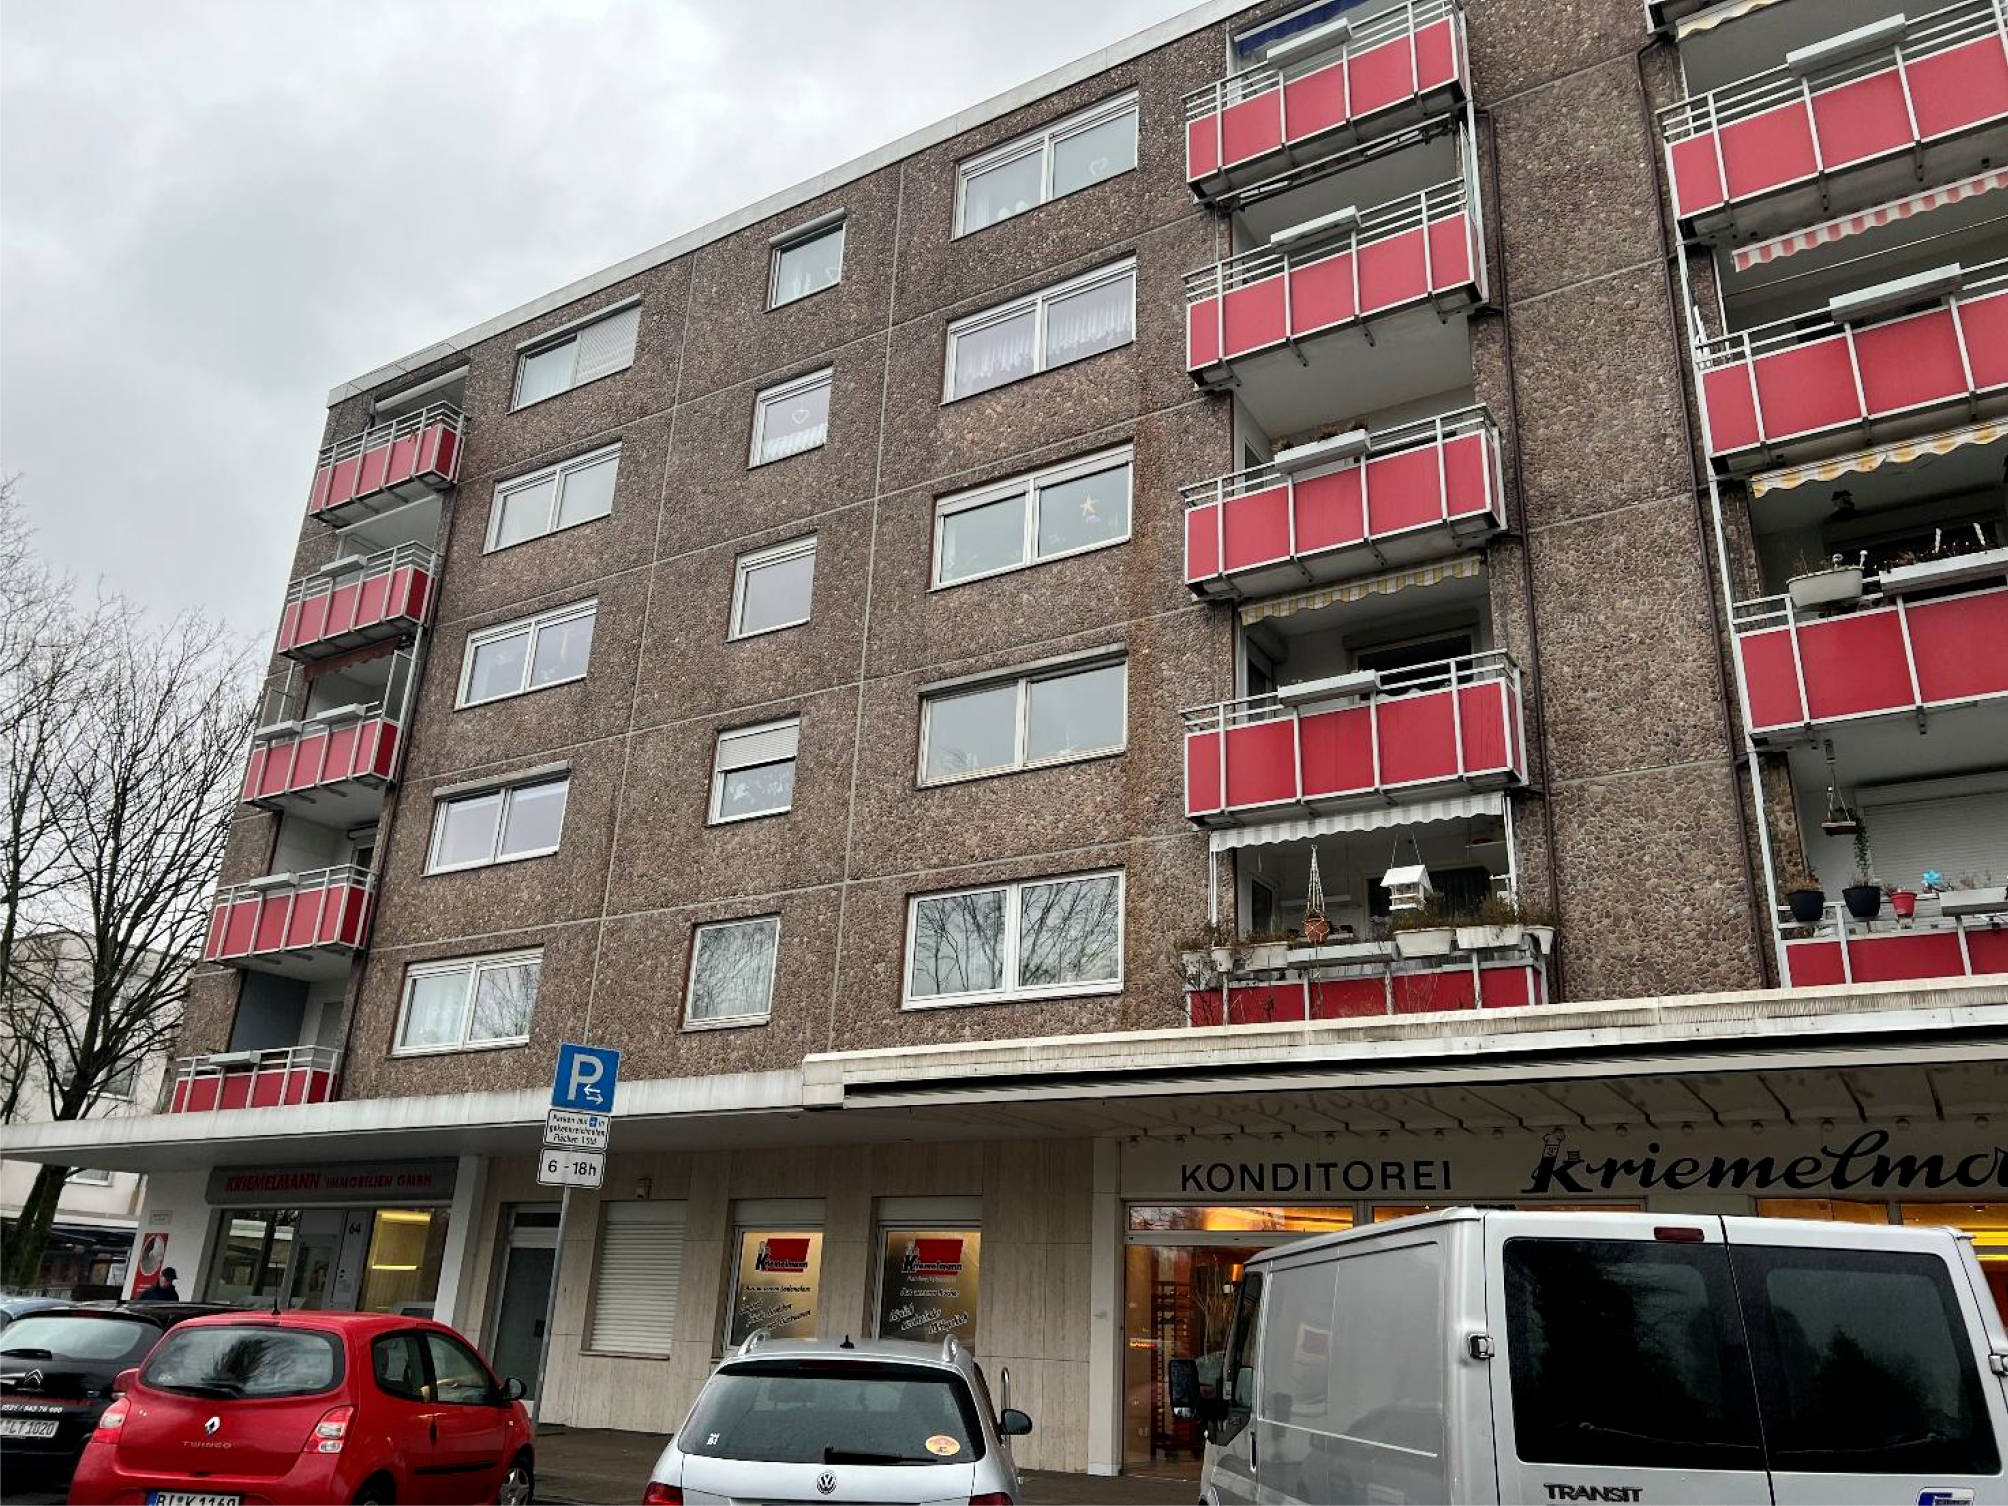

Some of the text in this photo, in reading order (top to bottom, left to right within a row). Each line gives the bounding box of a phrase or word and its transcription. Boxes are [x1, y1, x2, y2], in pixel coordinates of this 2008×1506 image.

[567, 1053, 604, 1101] P
[548, 1160, 558, 1173] 6
[1181, 1159, 1452, 1193] KONDITOREI
[225, 1172, 320, 1192] KRIEMELMANN
[348, 1222, 361, 1234] 64
[1543, 1482, 1644, 1503] TRANSIT
